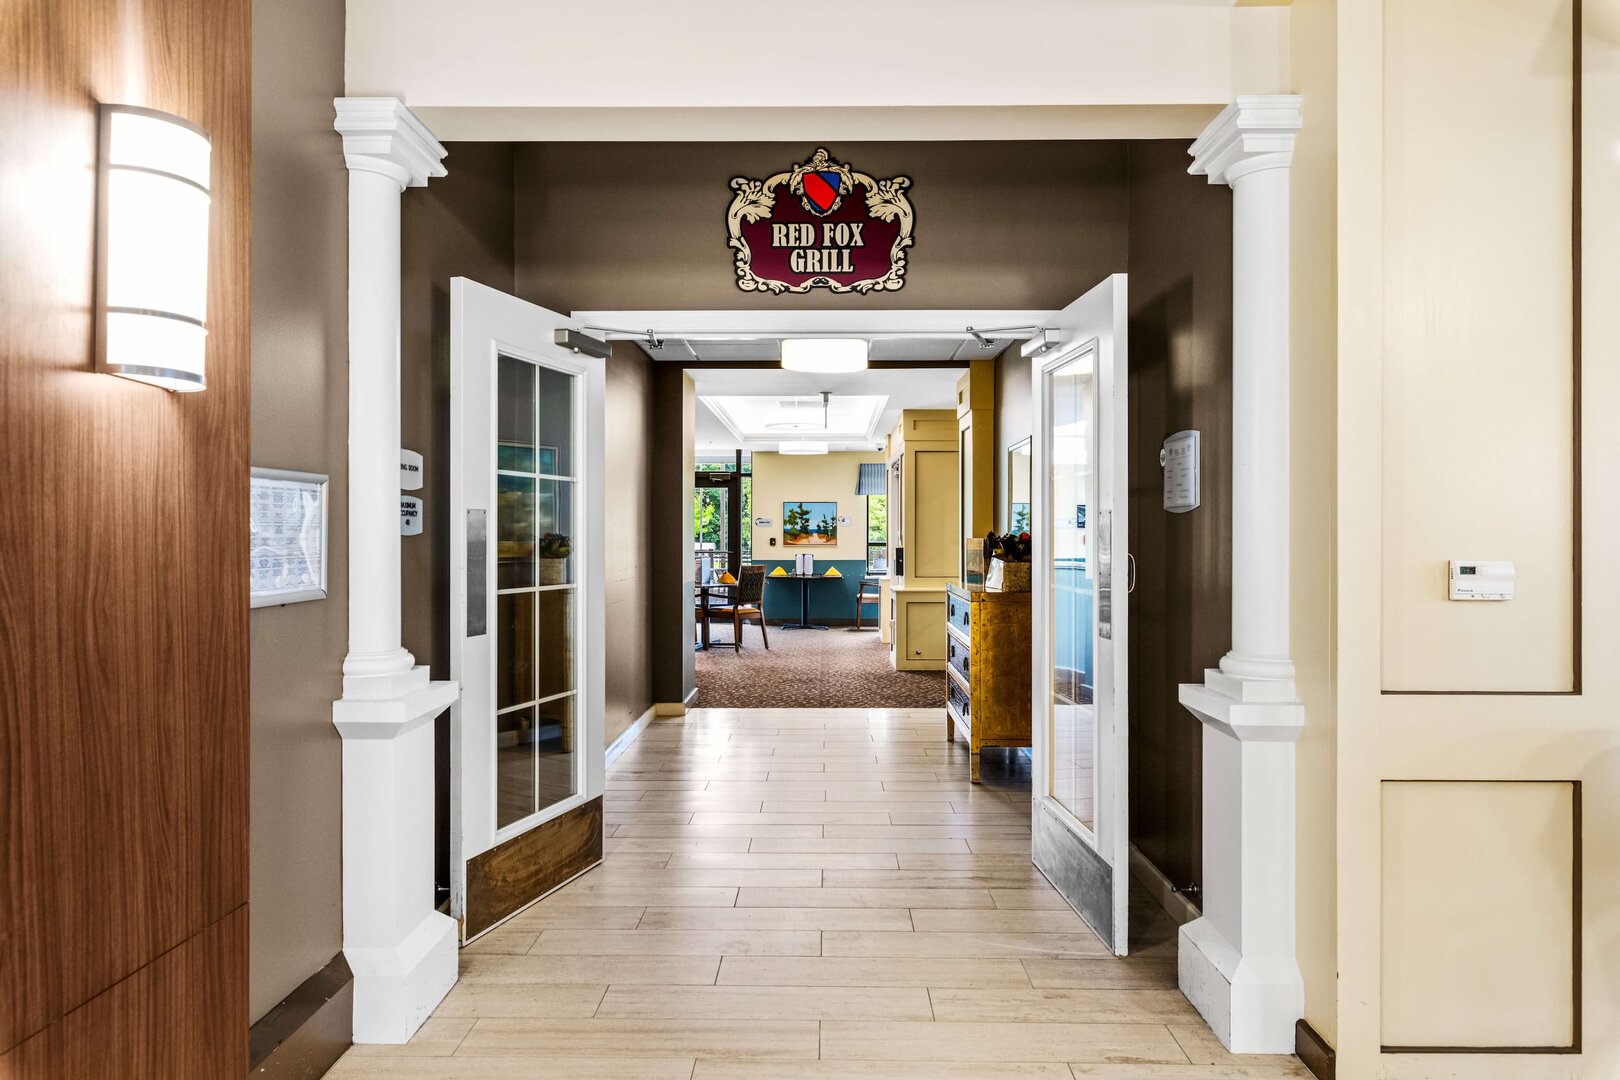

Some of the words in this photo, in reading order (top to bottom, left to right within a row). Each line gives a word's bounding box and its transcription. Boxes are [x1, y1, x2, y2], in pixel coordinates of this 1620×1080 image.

[772, 223, 815, 247] RED
[822, 223, 864, 247] FOX
[790, 249, 853, 273] GRILL
